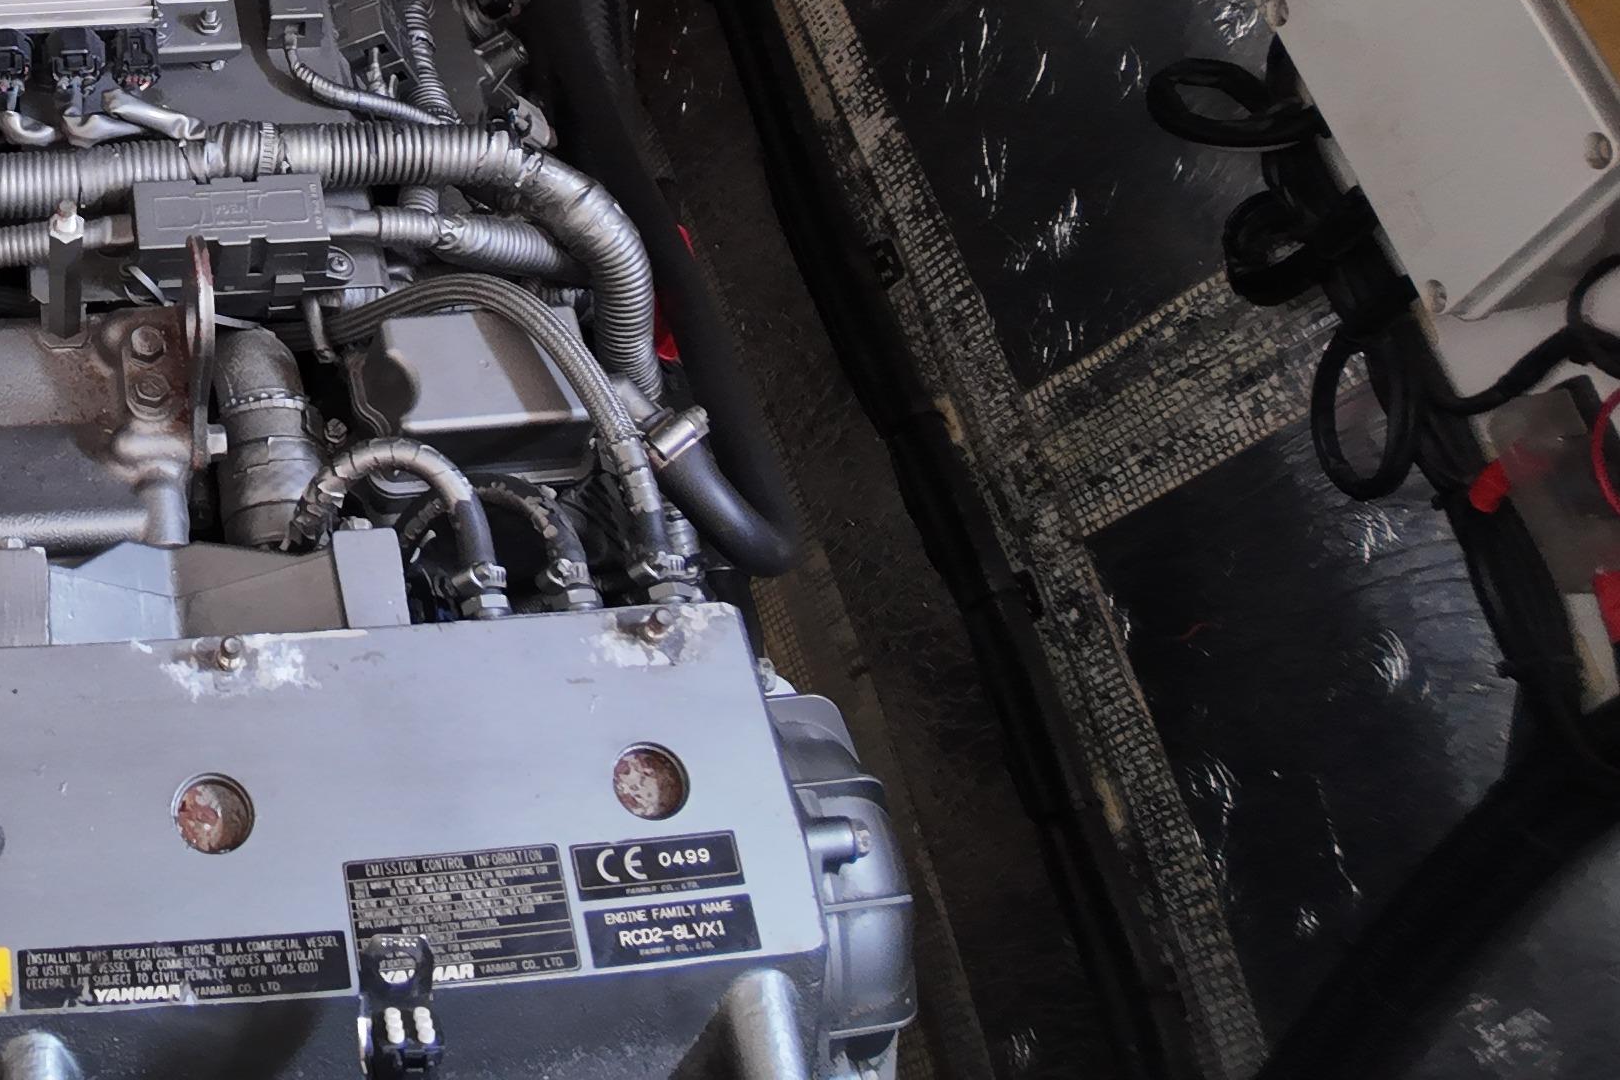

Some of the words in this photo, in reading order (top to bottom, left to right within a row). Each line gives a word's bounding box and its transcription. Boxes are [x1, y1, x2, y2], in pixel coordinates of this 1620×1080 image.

[365, 860, 417, 877] EMISSION
[422, 857, 467, 873] CONTROL
[473, 849, 543, 868] INFORMATION
[596, 846, 648, 883] CE
[658, 848, 711, 867] 0499
[604, 911, 648, 925] ENGINE
[652, 904, 697, 920] FAMILY
[701, 900, 734, 913] NAME
[618, 919, 727, 948] RCD2-8LVX1
[25, 967, 38, 978] OR
[42, 964, 72, 977] USING
[99, 961, 130, 975] VESSEL
[136, 959, 153, 971] FOR
[156, 956, 211, 971] COMMERCIAL
[216, 953, 261, 966] PURPOSES
[264, 951, 282, 963] MAY
[286, 948, 325, 961] VIOLATE
[27, 950, 81, 966] INSTALLING
[113, 946, 177, 961] RECREATIONAL
[183, 944, 215, 956] ENGINE
[222, 942, 233, 954] IN
[236, 942, 244, 953] A
[247, 938, 301, 952] COMMERCIAL
[306, 935, 339, 948] VESSEL
[26, 977, 66, 990] FEDERAL
[92, 973, 131, 987] SUBJECT
[137, 972, 149, 984] TO
[152, 970, 180, 983] CIVIL
[249, 965, 268, 977] CFR
[94, 984, 181, 1003] YANMAR
